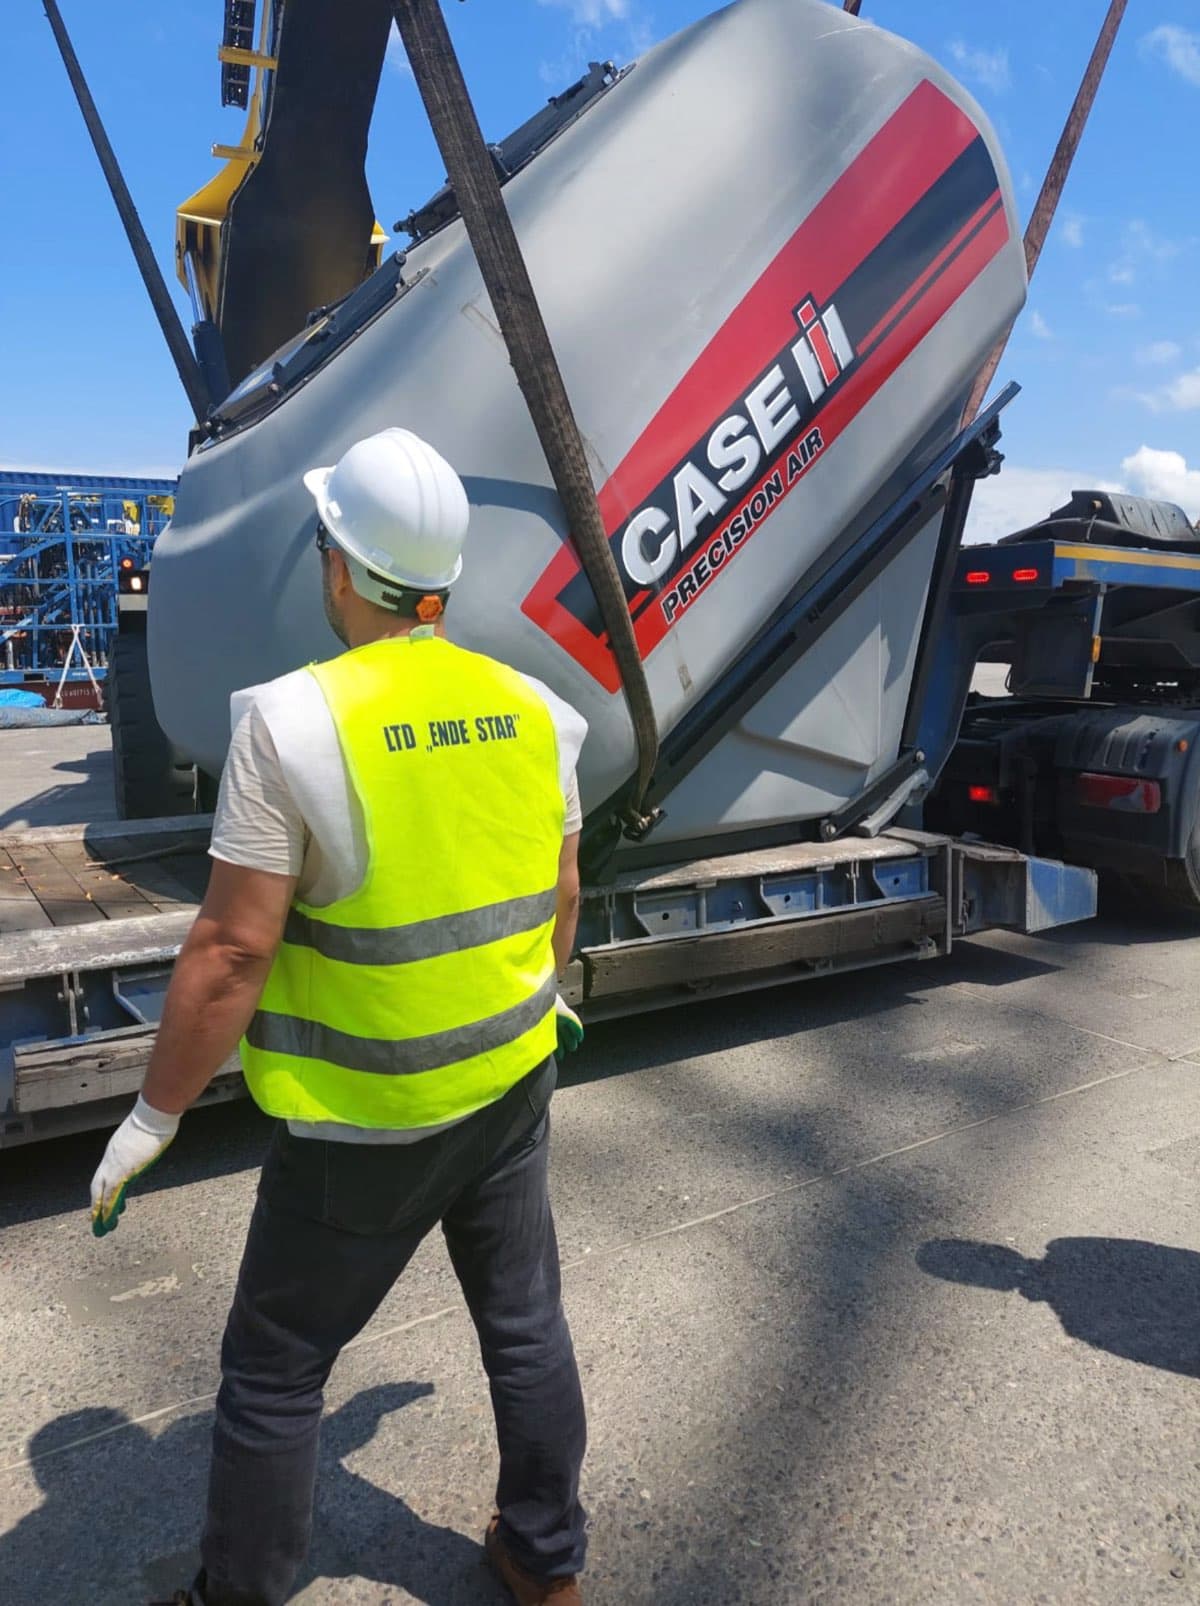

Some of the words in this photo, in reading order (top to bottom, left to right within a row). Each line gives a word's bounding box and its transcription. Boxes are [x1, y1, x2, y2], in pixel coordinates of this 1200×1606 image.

[622, 364, 800, 585] CASE
[661, 474, 784, 624] PRECISION
[787, 427, 825, 486] AIR
[383, 723, 416, 752] LTD
